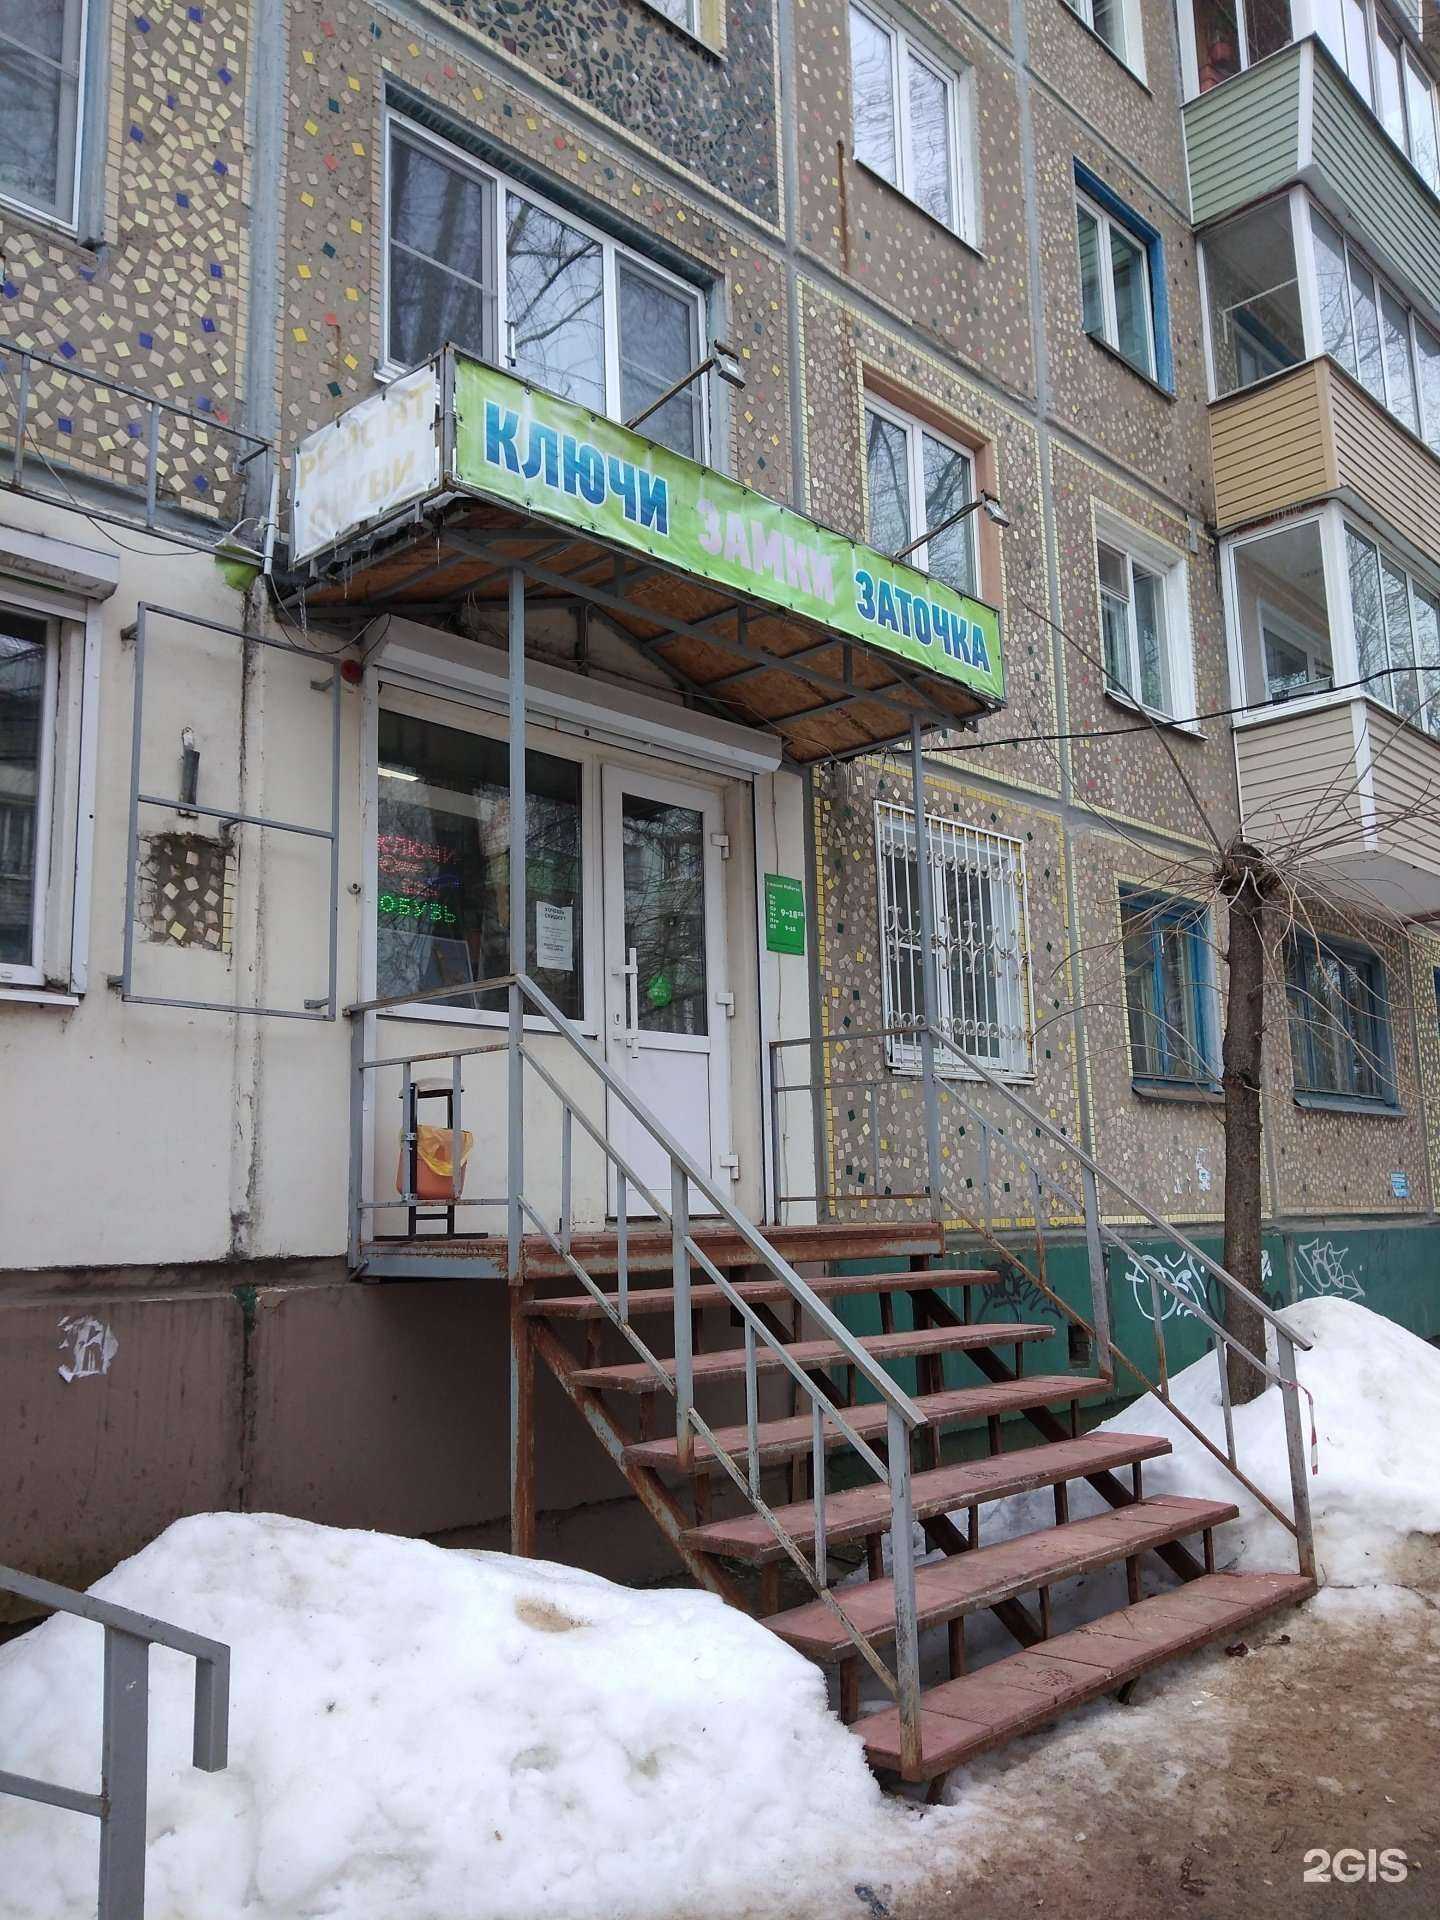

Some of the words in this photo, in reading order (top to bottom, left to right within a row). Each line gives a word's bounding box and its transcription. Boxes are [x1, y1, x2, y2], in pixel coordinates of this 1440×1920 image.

[484, 399, 670, 537] КЛЮЧИ
[697, 499, 835, 604] ЗАМКИ
[854, 568, 992, 674] ЗАТОЧКА
[380, 895, 456, 923] ОБУВЬ
